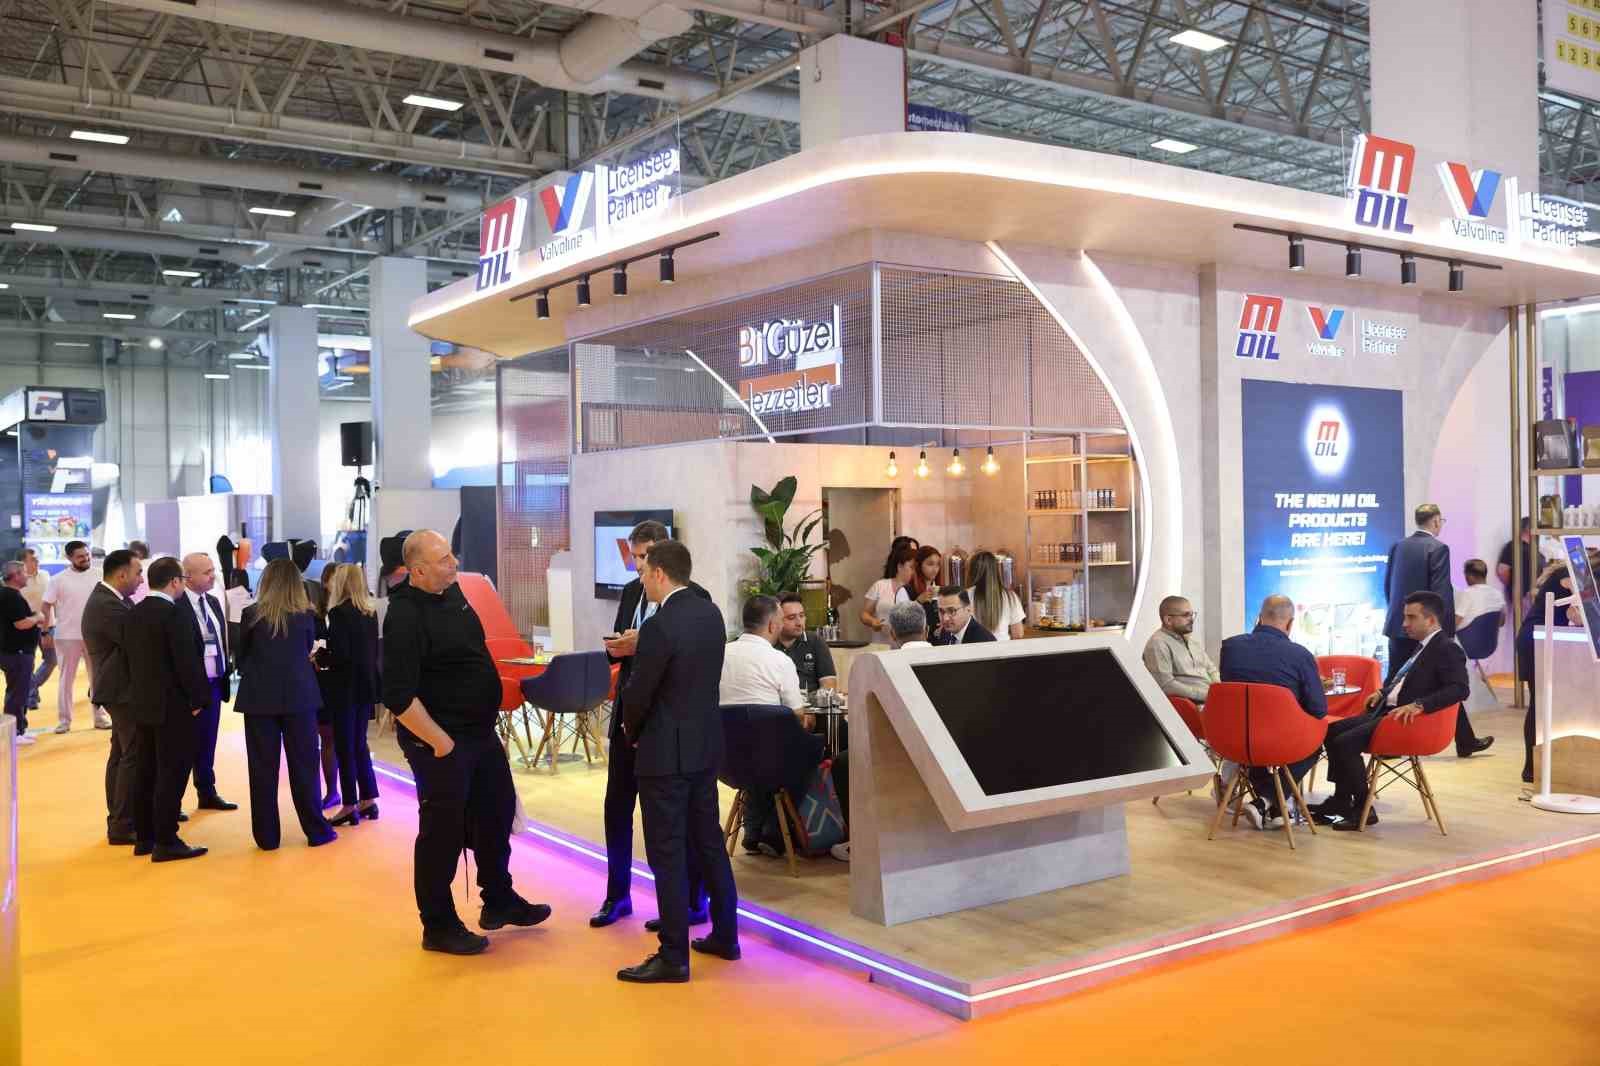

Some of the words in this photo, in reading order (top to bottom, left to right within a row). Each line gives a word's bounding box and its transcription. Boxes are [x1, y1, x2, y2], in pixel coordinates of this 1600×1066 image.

[606, 147, 674, 195] Licensee
[606, 184, 660, 225] Partner
[1354, 187, 1415, 234] OIL
[1451, 219, 1505, 244] Valvoline
[538, 233, 583, 262] Valvoline
[1235, 331, 1281, 361] OIL
[1314, 442, 1339, 457] OIL
[1274, 493, 1305, 509] THE
[1306, 493, 1340, 508] NEW
[1357, 493, 1380, 508] OIL
[1288, 512, 1368, 528] PRODUCTS
[1290, 532, 1322, 548] ARE
